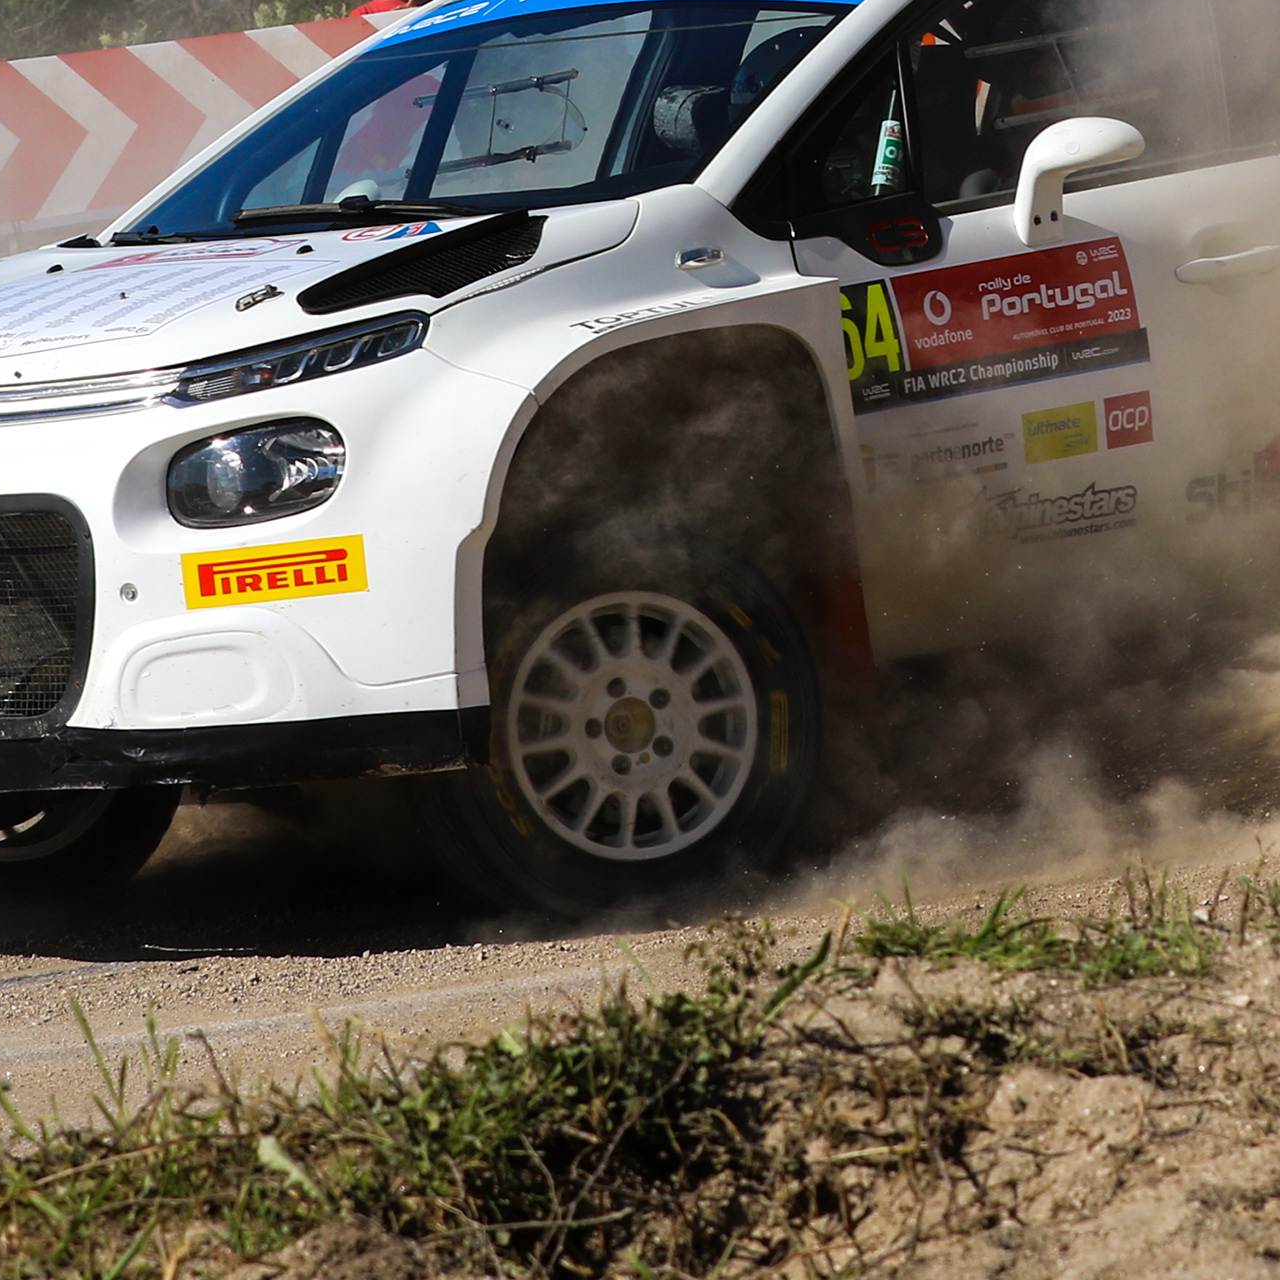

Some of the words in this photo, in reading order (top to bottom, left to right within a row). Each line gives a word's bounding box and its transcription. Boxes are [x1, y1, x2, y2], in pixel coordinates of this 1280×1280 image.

[978, 277, 1012, 293] rally
[1012, 273, 1032, 286] de
[981, 271, 1128, 321] Portugal
[1049, 324, 1065, 334] CLUB
[1065, 323, 1074, 331] DE
[1074, 318, 1106, 330] PORTUGAL
[1106, 307, 1132, 324] 2023
[914, 327, 973, 351] vodafone
[903, 373, 927, 395] FIA
[928, 367, 967, 391] WRC2
[969, 352, 1059, 382] Championship
[1027, 415, 1081, 437] ultimate
[1108, 405, 1150, 432] acp
[976, 482, 1138, 540] pinestars
[197, 548, 348, 597] PIRELLI
